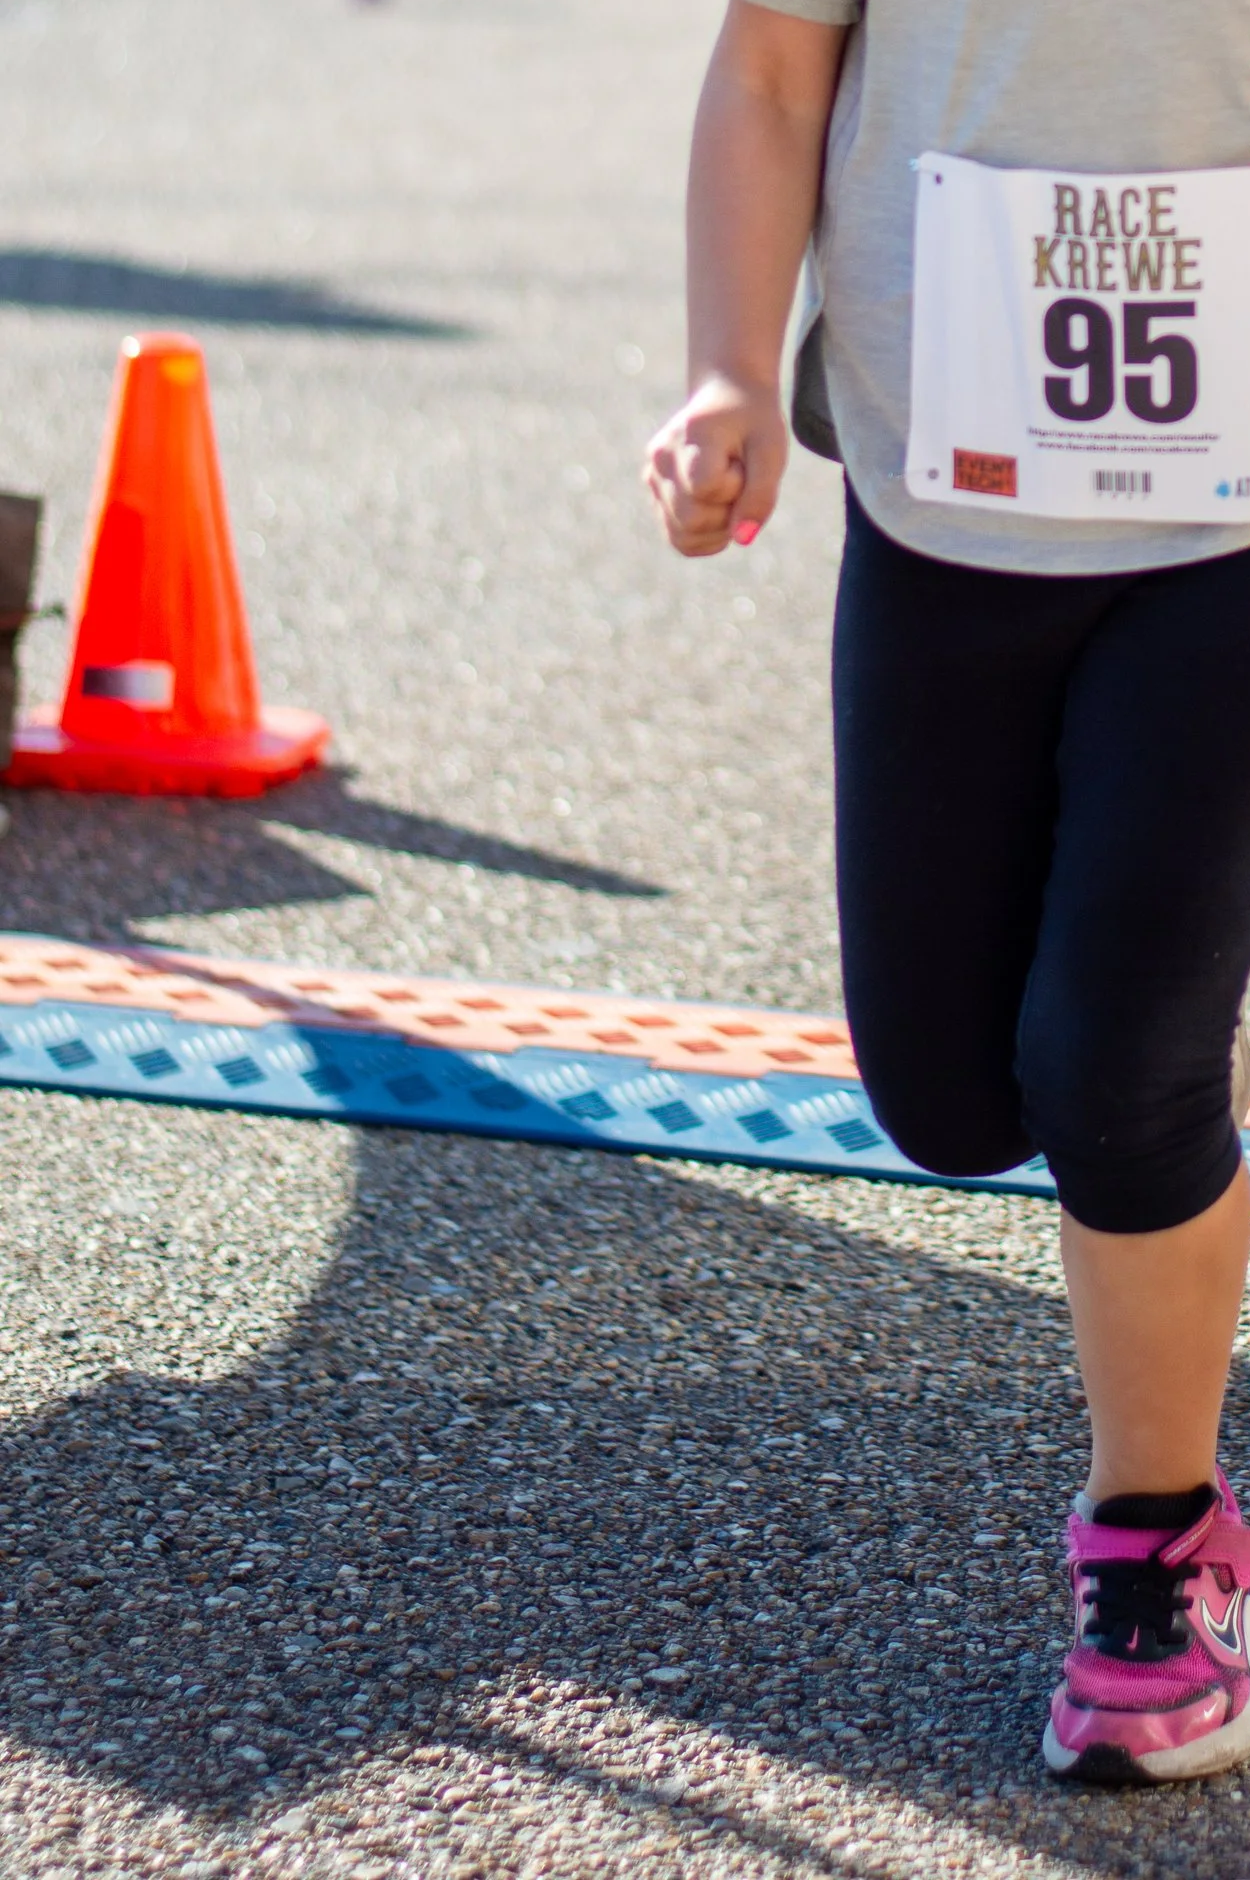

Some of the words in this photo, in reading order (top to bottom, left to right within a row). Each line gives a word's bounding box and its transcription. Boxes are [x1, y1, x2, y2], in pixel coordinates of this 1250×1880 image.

[1054, 183, 1177, 237] RACE
[1034, 236, 1203, 291] KREWE
[1043, 297, 1198, 424] 95
